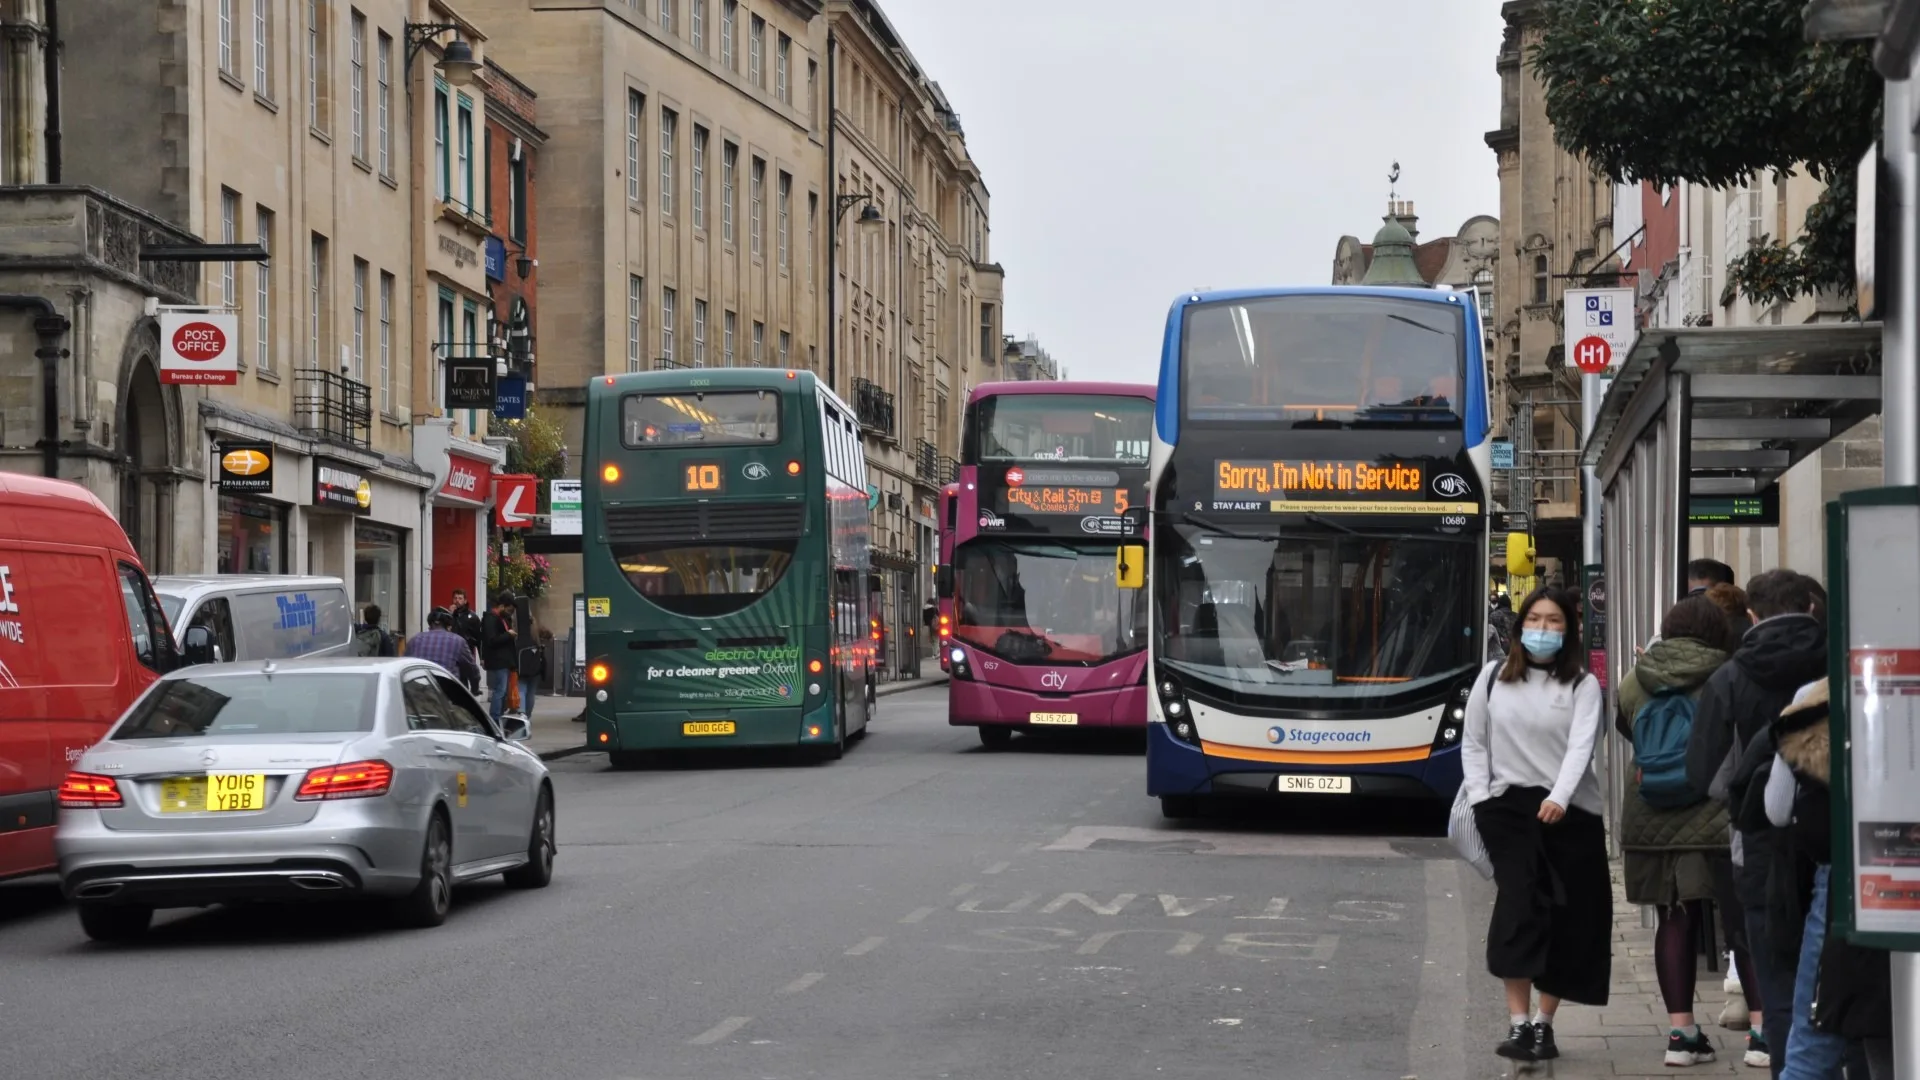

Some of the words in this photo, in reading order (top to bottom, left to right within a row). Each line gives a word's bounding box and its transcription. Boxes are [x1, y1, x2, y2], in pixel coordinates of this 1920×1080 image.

[184, 330, 216, 340] POST
[177, 341, 220, 352] OFFICE
[1580, 345, 1604, 364] H1
[451, 388, 490, 396] MUSEUM
[686, 465, 719, 490] 10
[1219, 462, 1271, 493] Sorry,
[1273, 462, 1298, 489] I'm
[1302, 463, 1334, 490] Not
[1337, 462, 1352, 490] in
[1356, 462, 1420, 492] Service
[1007, 488, 1032, 505] City
[1033, 492, 1042, 503] &
[1042, 488, 1064, 503] Rail
[1068, 490, 1090, 504] Stn
[1114, 488, 1129, 514] 5
[1234, 502, 1262, 510] ALERT
[1389, 505, 1417, 513] covering
[1040, 504, 1068, 513] Cowley
[1068, 504, 1080, 512] Rd
[1442, 516, 1466, 526] 10680
[704, 648, 755, 661] electric
[756, 647, 799, 662] hybrid
[1854, 652, 1898, 666] oord
[647, 666, 666, 680] for
[666, 669, 674, 677] a
[676, 666, 716, 677] cleaner
[718, 666, 760, 678] greener
[762, 662, 797, 676] Oxford
[984, 662, 999, 670] 657
[1041, 670, 1068, 690] city
[724, 687, 776, 699] stagecoach
[1036, 714, 1054, 722] SL15
[1056, 714, 1073, 722] ZGJ
[712, 723, 729, 732] GGE
[1289, 728, 1371, 744] Stagecoach
[216, 774, 255, 791] YO16
[1287, 777, 1314, 788] SN16
[1318, 778, 1343, 789] OZJ
[217, 793, 252, 810] YBB
